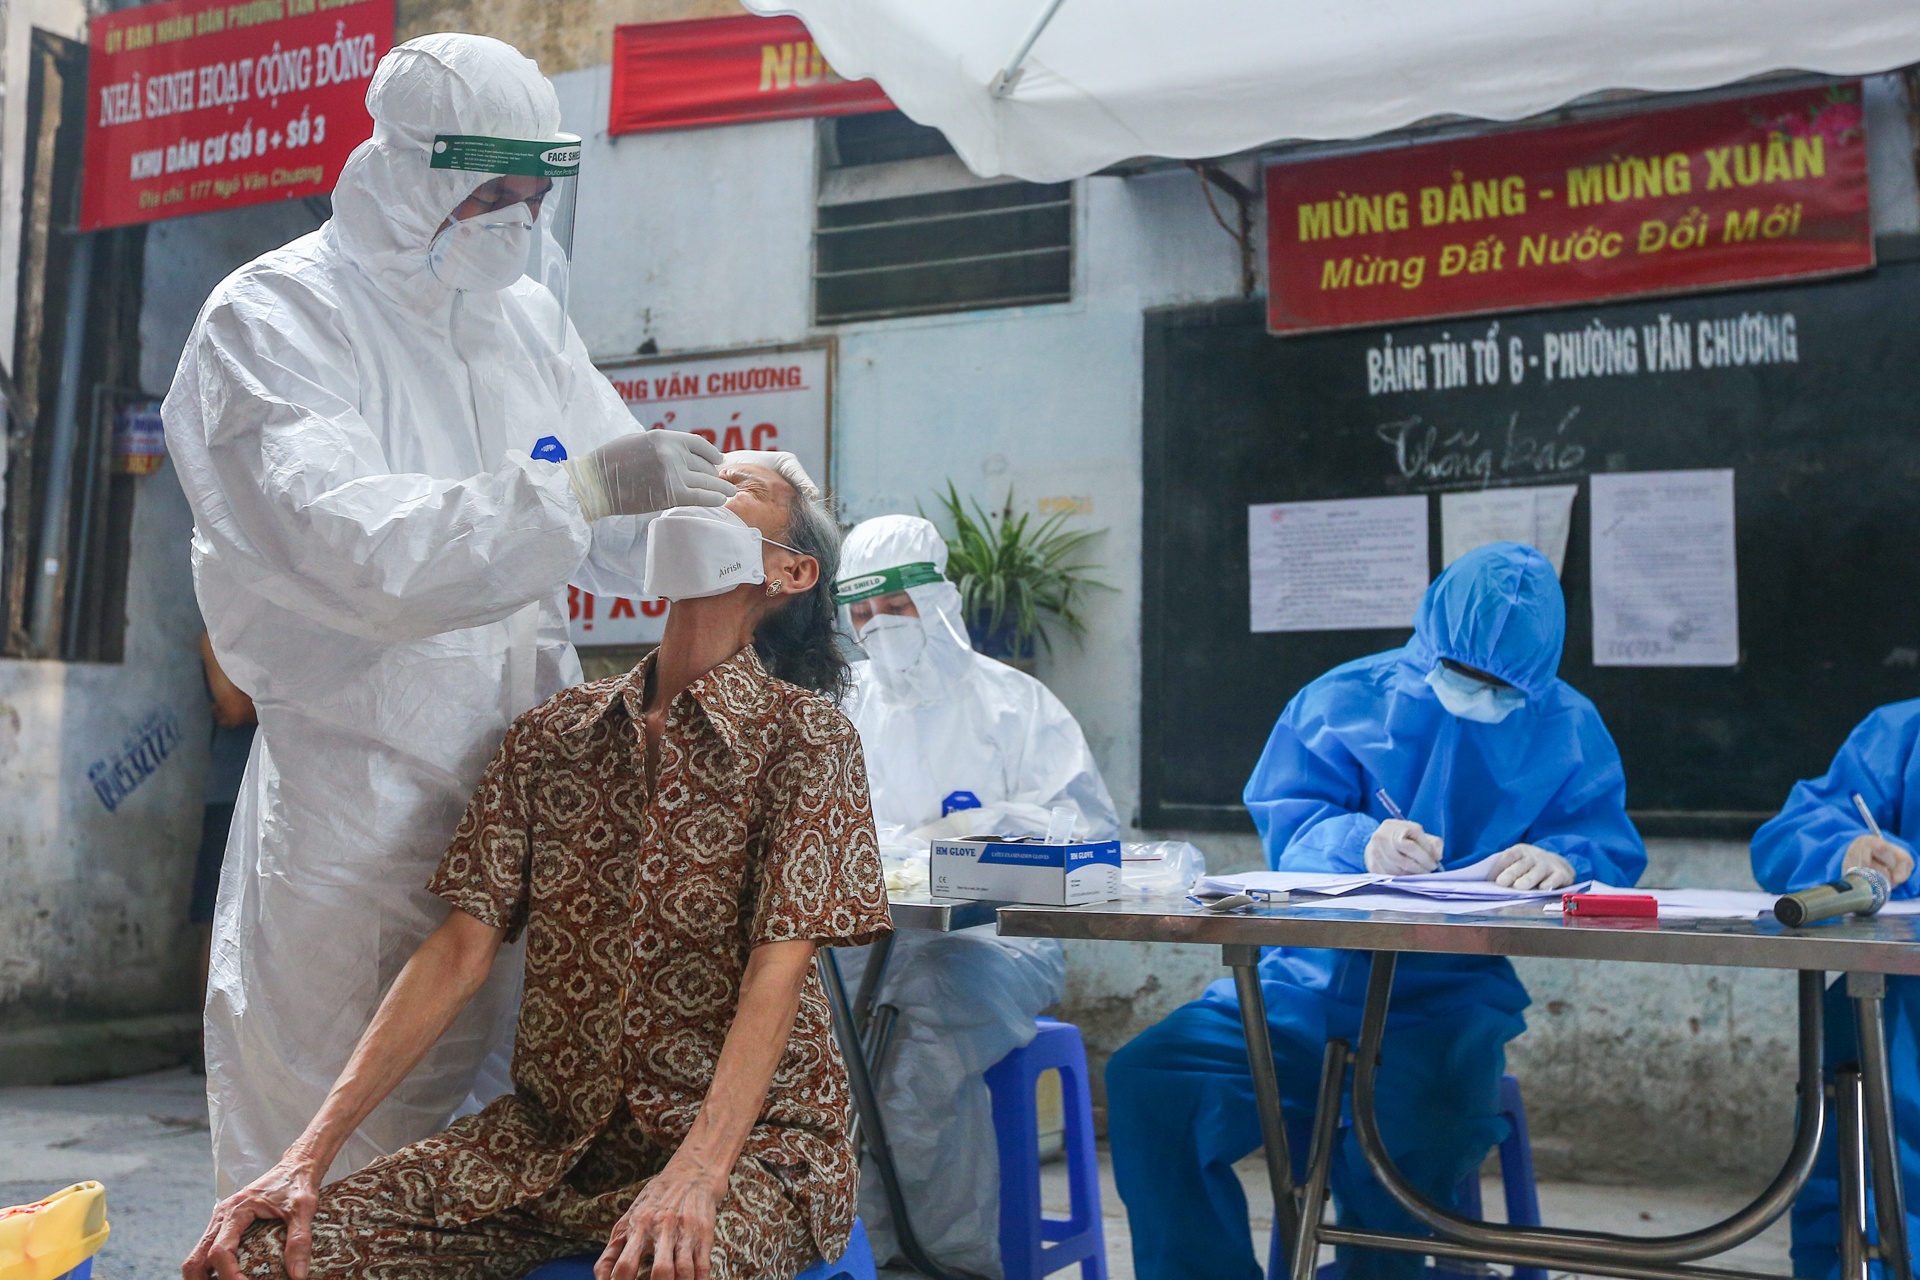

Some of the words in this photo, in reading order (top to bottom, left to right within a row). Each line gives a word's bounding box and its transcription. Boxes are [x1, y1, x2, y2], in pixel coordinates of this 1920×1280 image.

[99, 71, 142, 128] NHÀ
[146, 69, 195, 119] SINH
[197, 57, 253, 115] HOẠT
[255, 40, 312, 108] CỘNG
[315, 20, 376, 87] ĐỒNG
[130, 148, 163, 181] KHU
[286, 104, 310, 149] SỐ
[313, 114, 326, 144] 3
[547, 151, 567, 162] FACE
[1298, 190, 1409, 241] MỪNG
[1420, 170, 1526, 226] ĐẢNG
[1566, 152, 1692, 207] MỪNG
[1705, 131, 1825, 191] XUÂN
[1321, 254, 1425, 290] Mừng
[1439, 234, 1506, 277] Đất
[1518, 225, 1624, 267] Nước
[1637, 206, 1709, 254] Đổi
[1723, 202, 1803, 243] Mới
[1366, 332, 1427, 396] BẢNG
[1471, 320, 1500, 385] TỔ
[1509, 336, 1524, 384] 6
[1544, 317, 1639, 381] PHƯỜNG
[1642, 313, 1692, 373] VĂN
[1697, 311, 1799, 368] CHƯƠNG
[654, 370, 699, 398] VĂN
[706, 364, 802, 394] CHƯƠNG
[719, 561, 742, 578] Airish
[854, 578, 880, 590] SHIELD
[936, 846, 948, 856] HM
[950, 847, 976, 857] GLOVE
[1079, 851, 1094, 859] GLOVE
